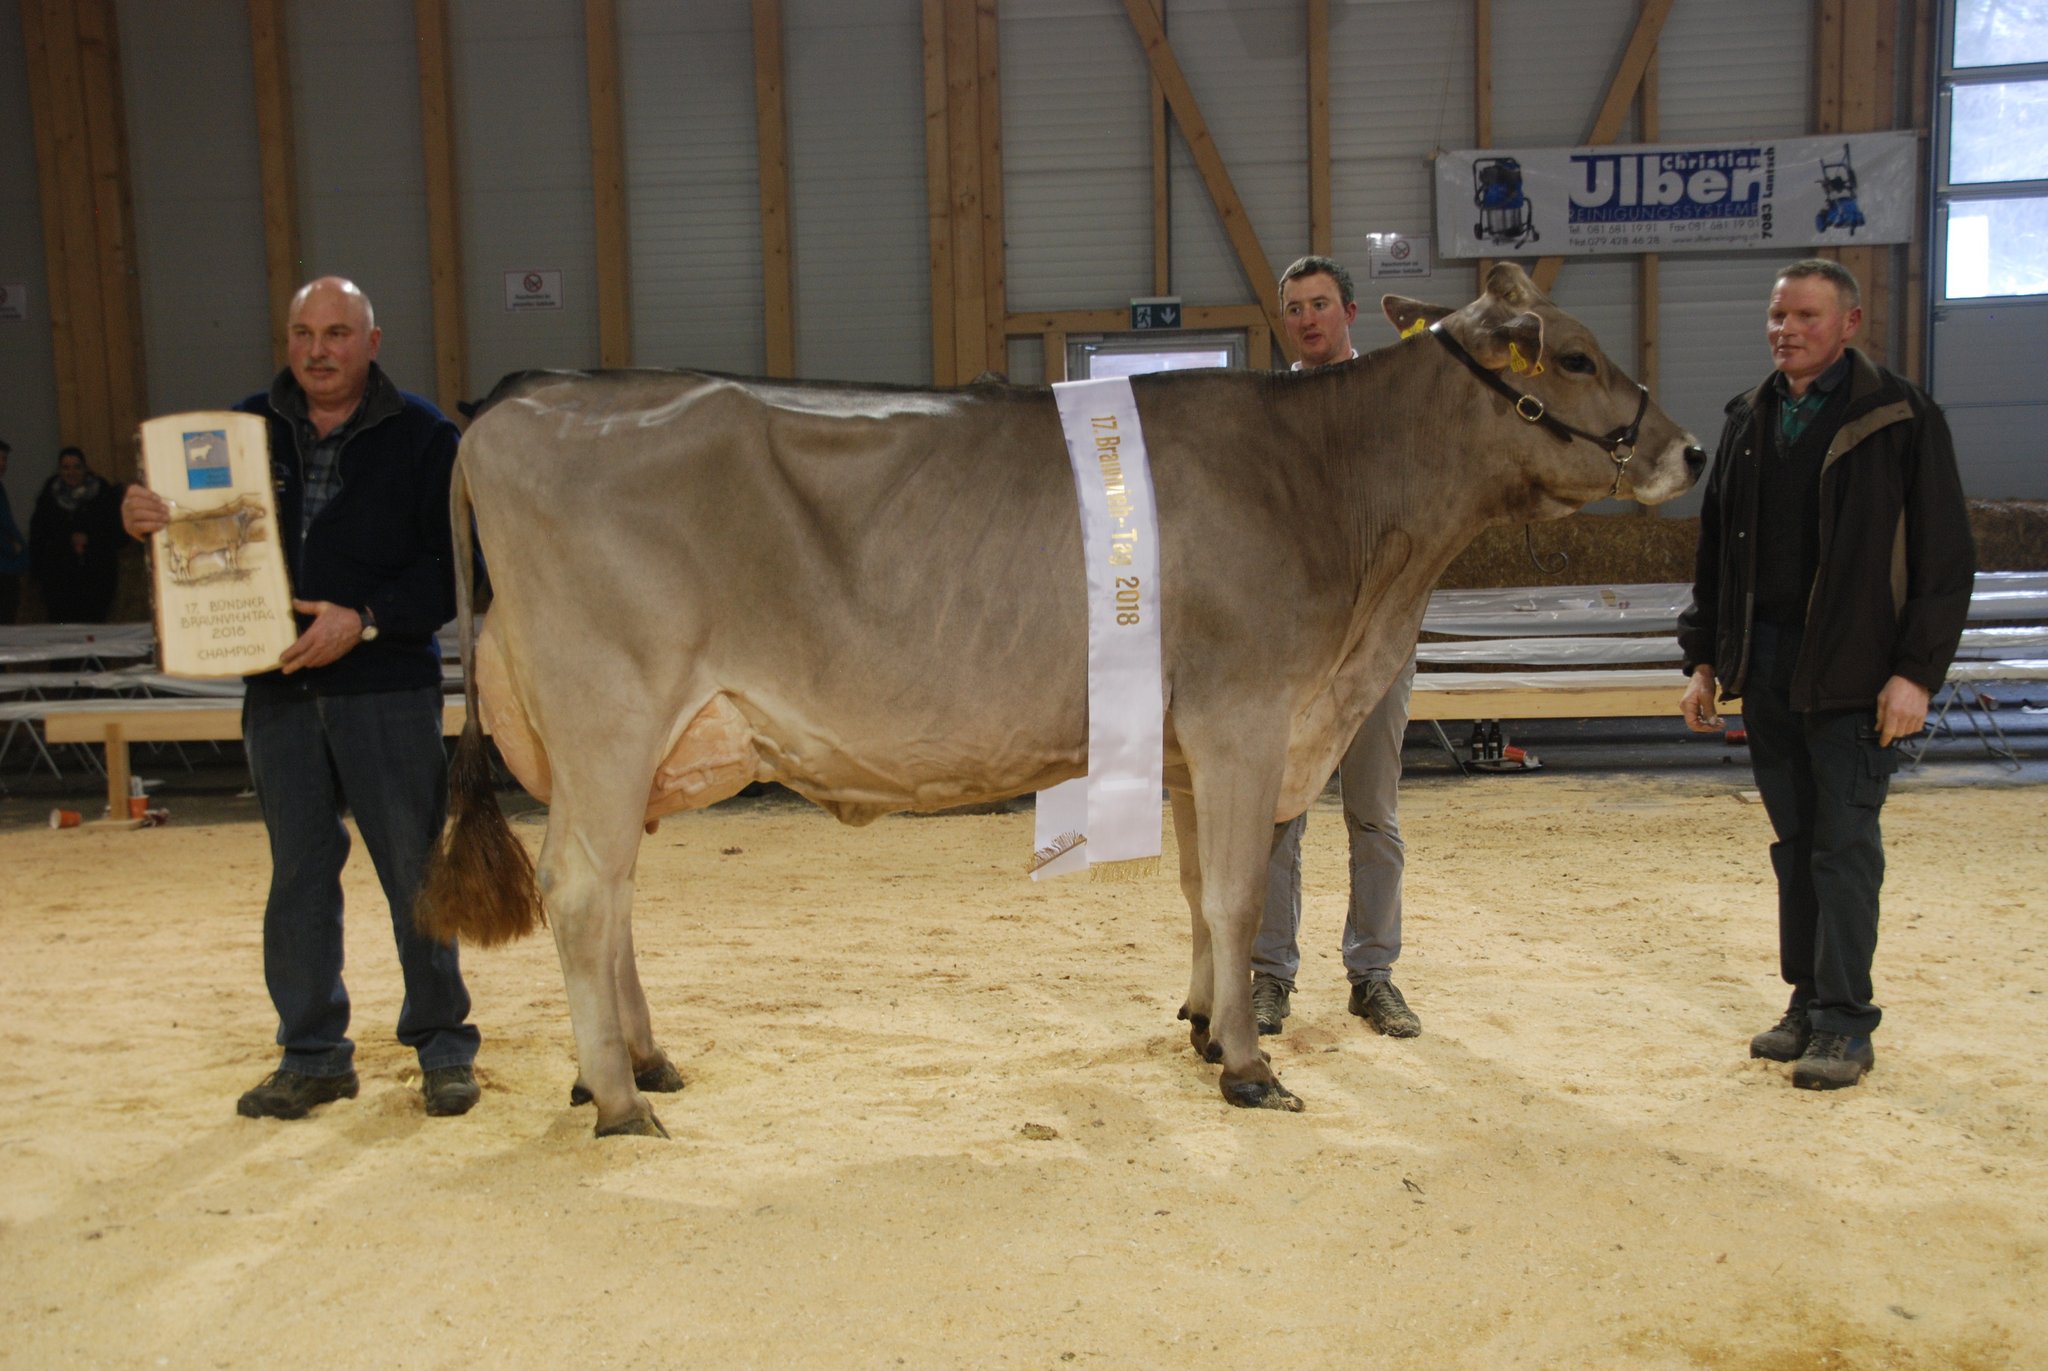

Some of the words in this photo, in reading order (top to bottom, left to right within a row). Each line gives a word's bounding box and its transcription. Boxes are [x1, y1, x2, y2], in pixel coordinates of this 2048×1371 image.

[1568, 155, 1761, 208] Ulber
[1763, 146, 1775, 199] Lantsch
[1587, 225, 1604, 234] 081
[1608, 224, 1626, 234] 681
[1761, 203, 1773, 239] 7083
[1115, 576, 1140, 626] 2018
[198, 643, 266, 660] CHAMPION
